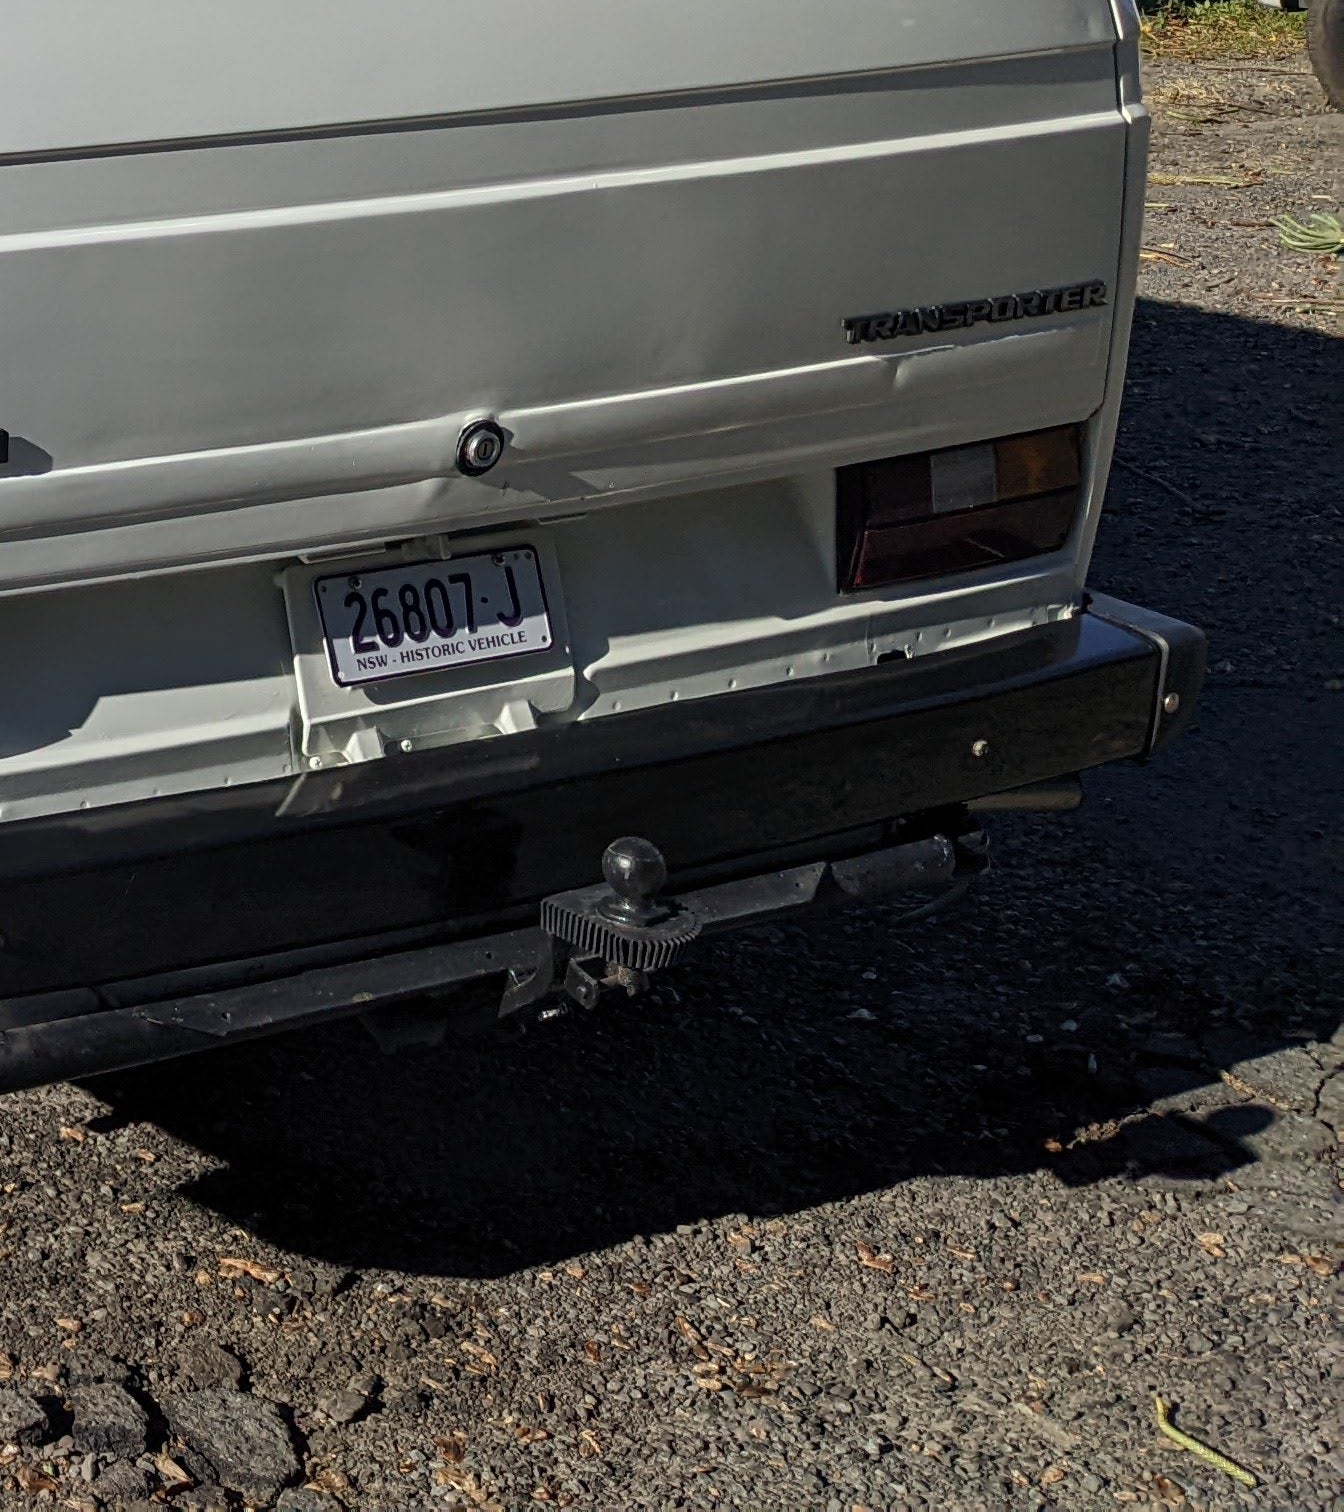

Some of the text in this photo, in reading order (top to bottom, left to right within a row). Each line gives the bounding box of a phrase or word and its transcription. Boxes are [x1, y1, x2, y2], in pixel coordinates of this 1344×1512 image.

[842, 279, 1108, 343] TRANSPORTER
[355, 656, 389, 672] NSW
[400, 640, 466, 664] HISTORIC
[467, 630, 528, 654] VEHICLE
